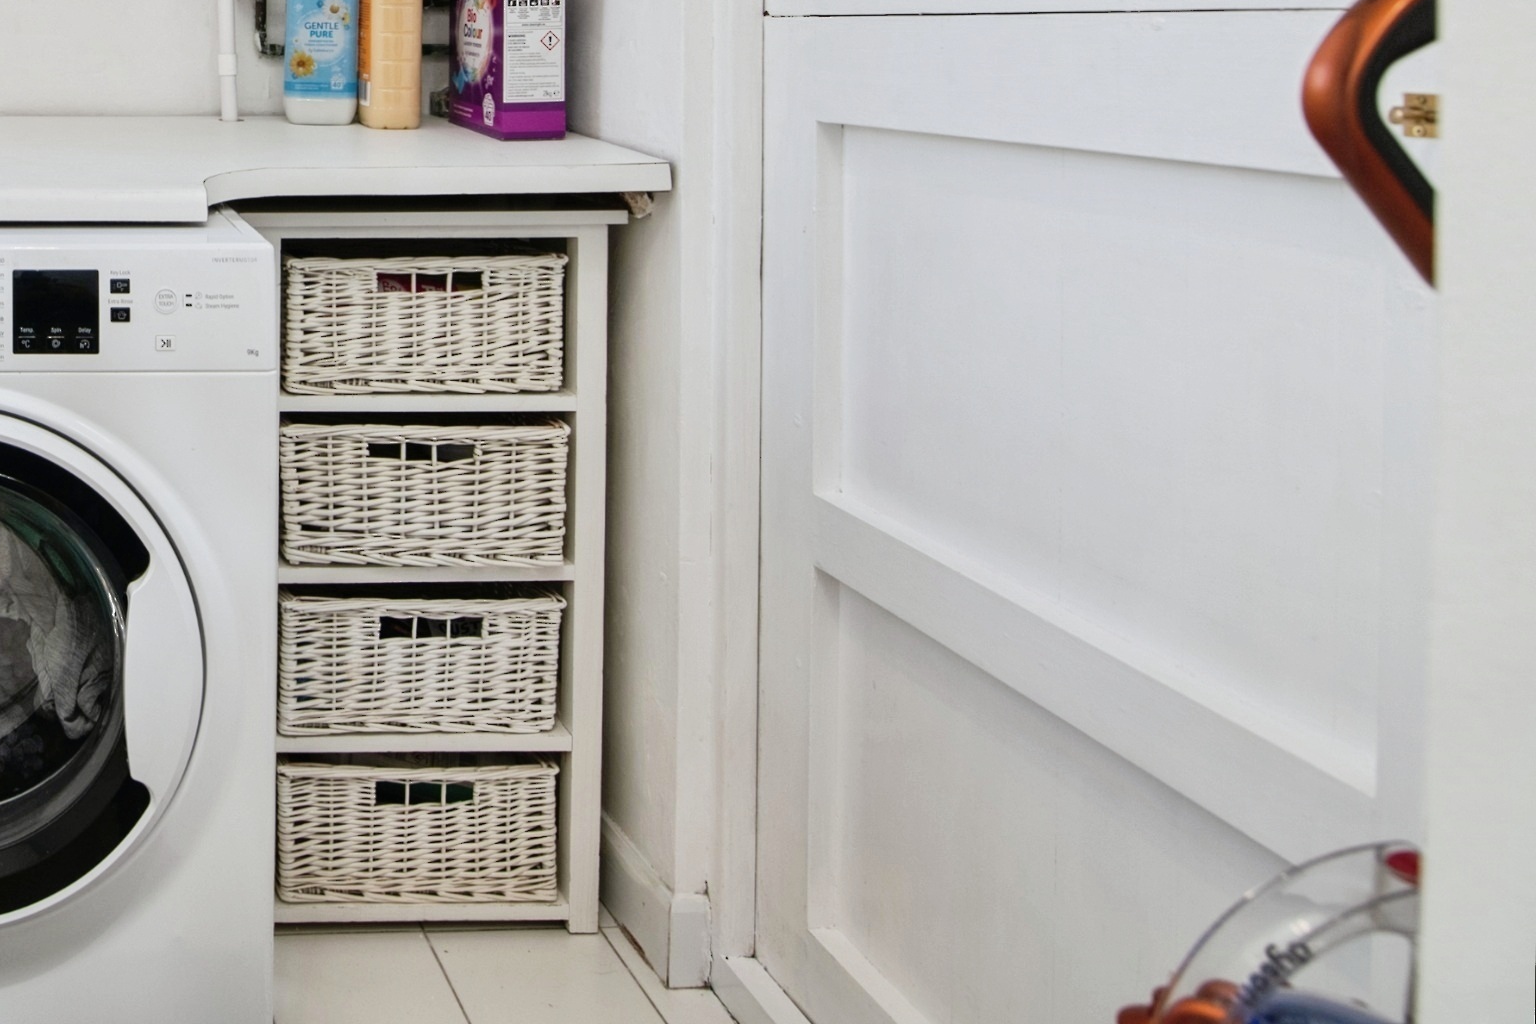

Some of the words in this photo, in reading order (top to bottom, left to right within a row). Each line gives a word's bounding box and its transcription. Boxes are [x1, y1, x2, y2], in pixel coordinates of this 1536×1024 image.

[466, 8, 477, 23] Bio
[304, 21, 339, 30] GENTLE
[463, 23, 483, 39] Colour
[309, 30, 334, 39] PURE
